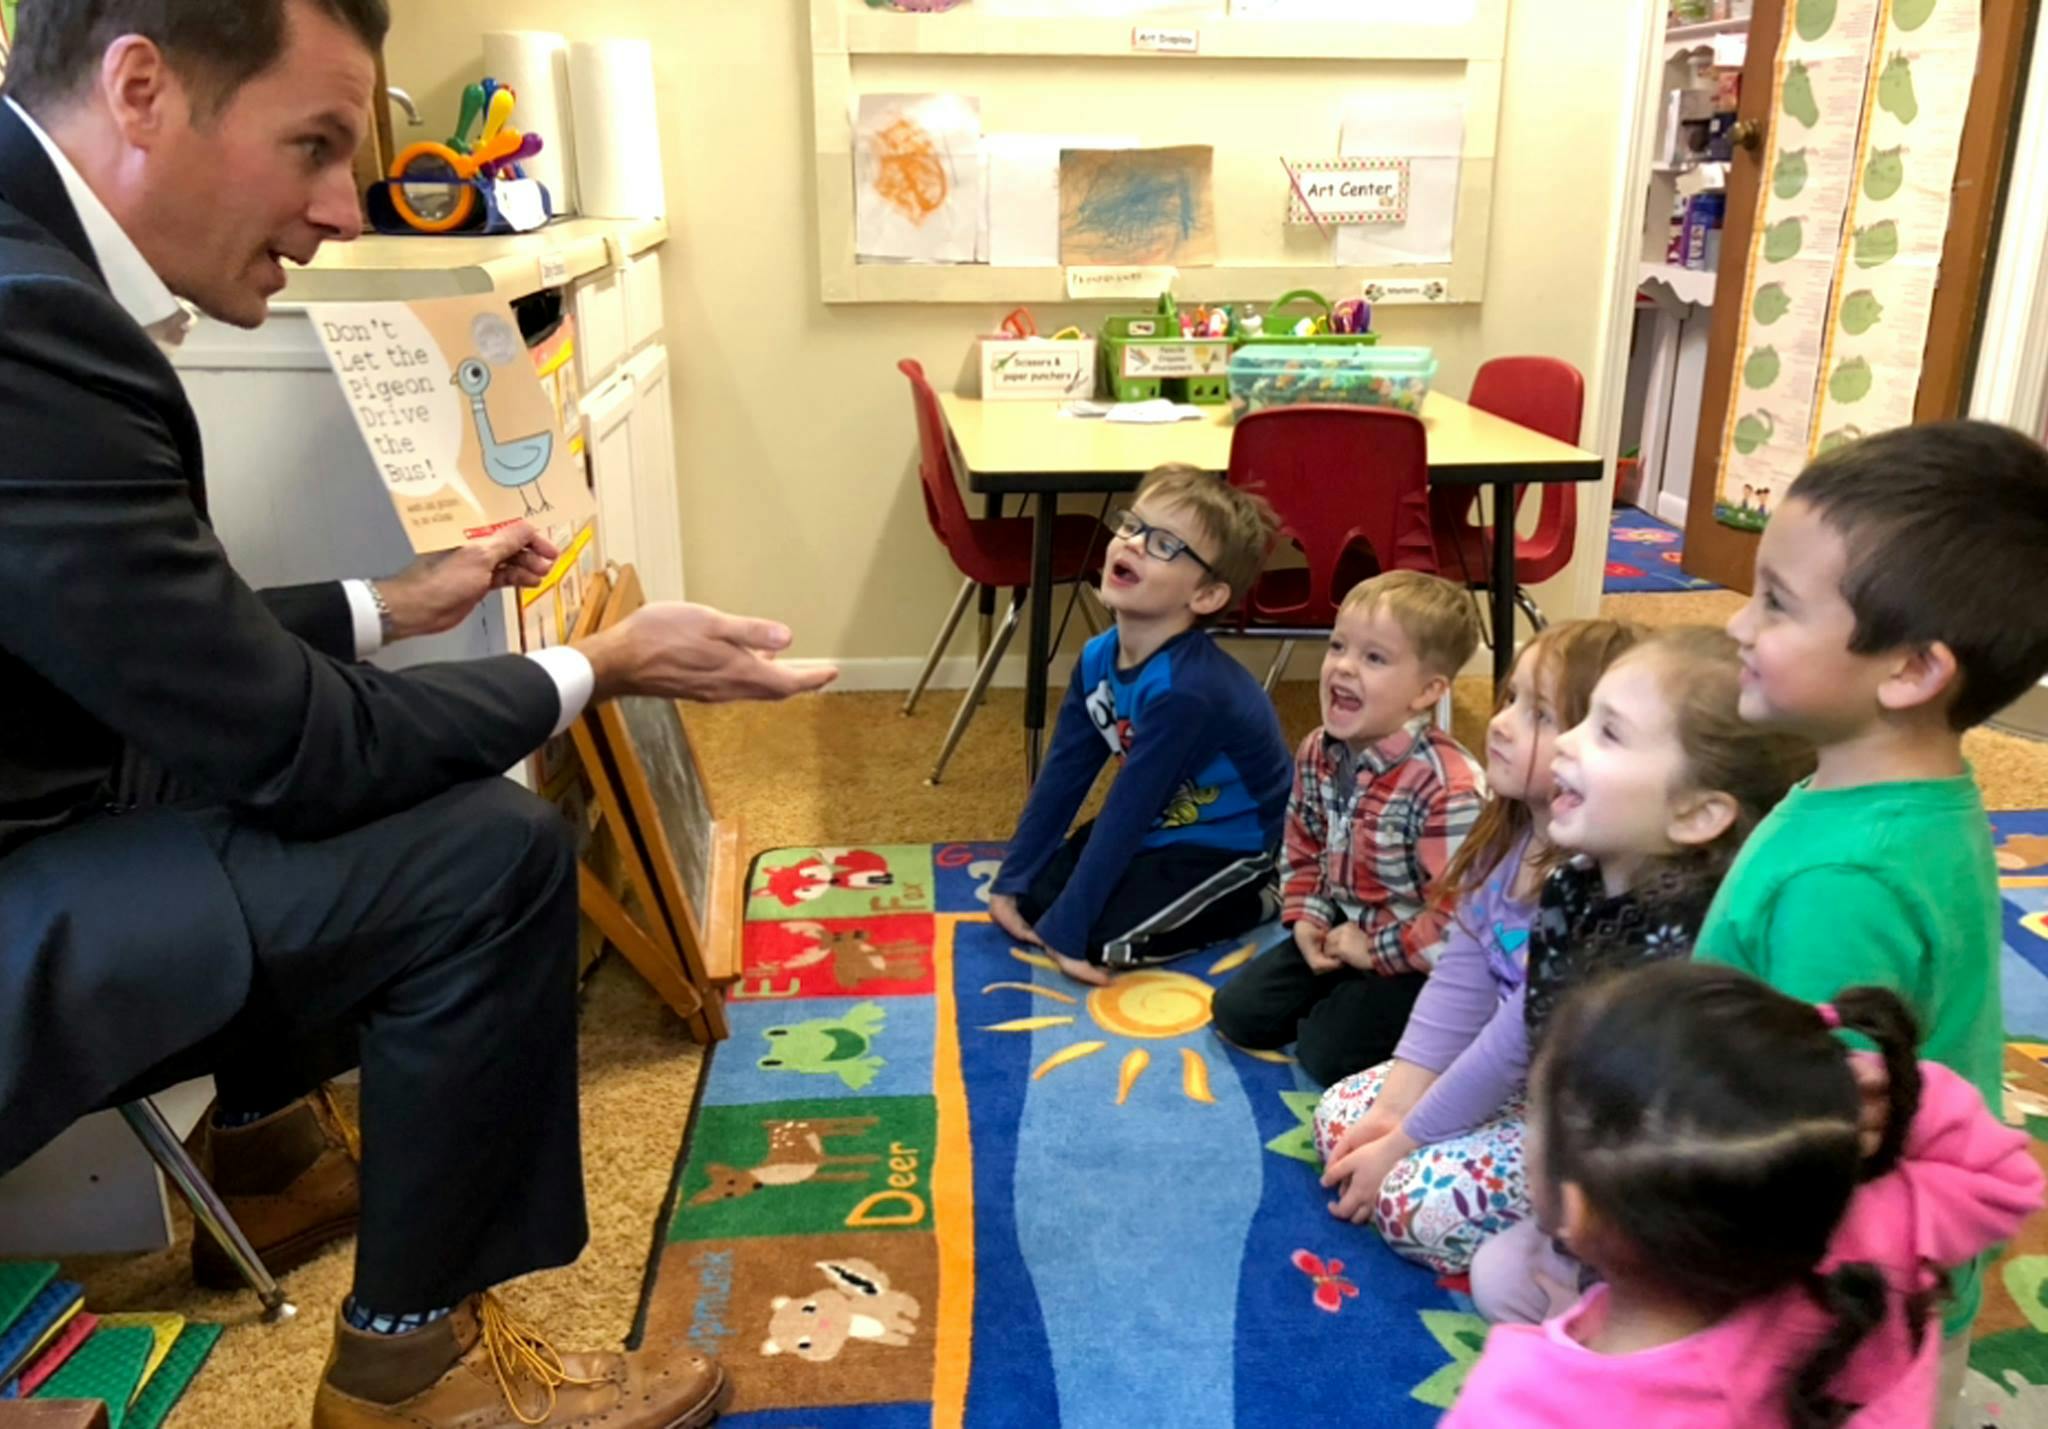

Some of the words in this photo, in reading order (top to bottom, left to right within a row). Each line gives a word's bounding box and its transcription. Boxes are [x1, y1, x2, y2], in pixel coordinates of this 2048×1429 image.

[1138, 33, 1156, 43] Art
[1307, 183, 1334, 197] Art
[1340, 181, 1393, 197] Center
[322, 318, 399, 342] Don't
[334, 349, 381, 372] Let
[386, 344, 429, 367] the
[1013, 357, 1052, 368] Scissors
[1054, 356, 1061, 367] &
[348, 376, 436, 402] Pigeon
[1003, 373, 1028, 383] paper
[1030, 371, 1071, 383] punchers
[359, 403, 430, 428] Drive
[373, 434, 416, 455] the
[383, 458, 437, 483] Bus!
[869, 882, 928, 913] Fox
[844, 1141, 926, 1227] Deer
